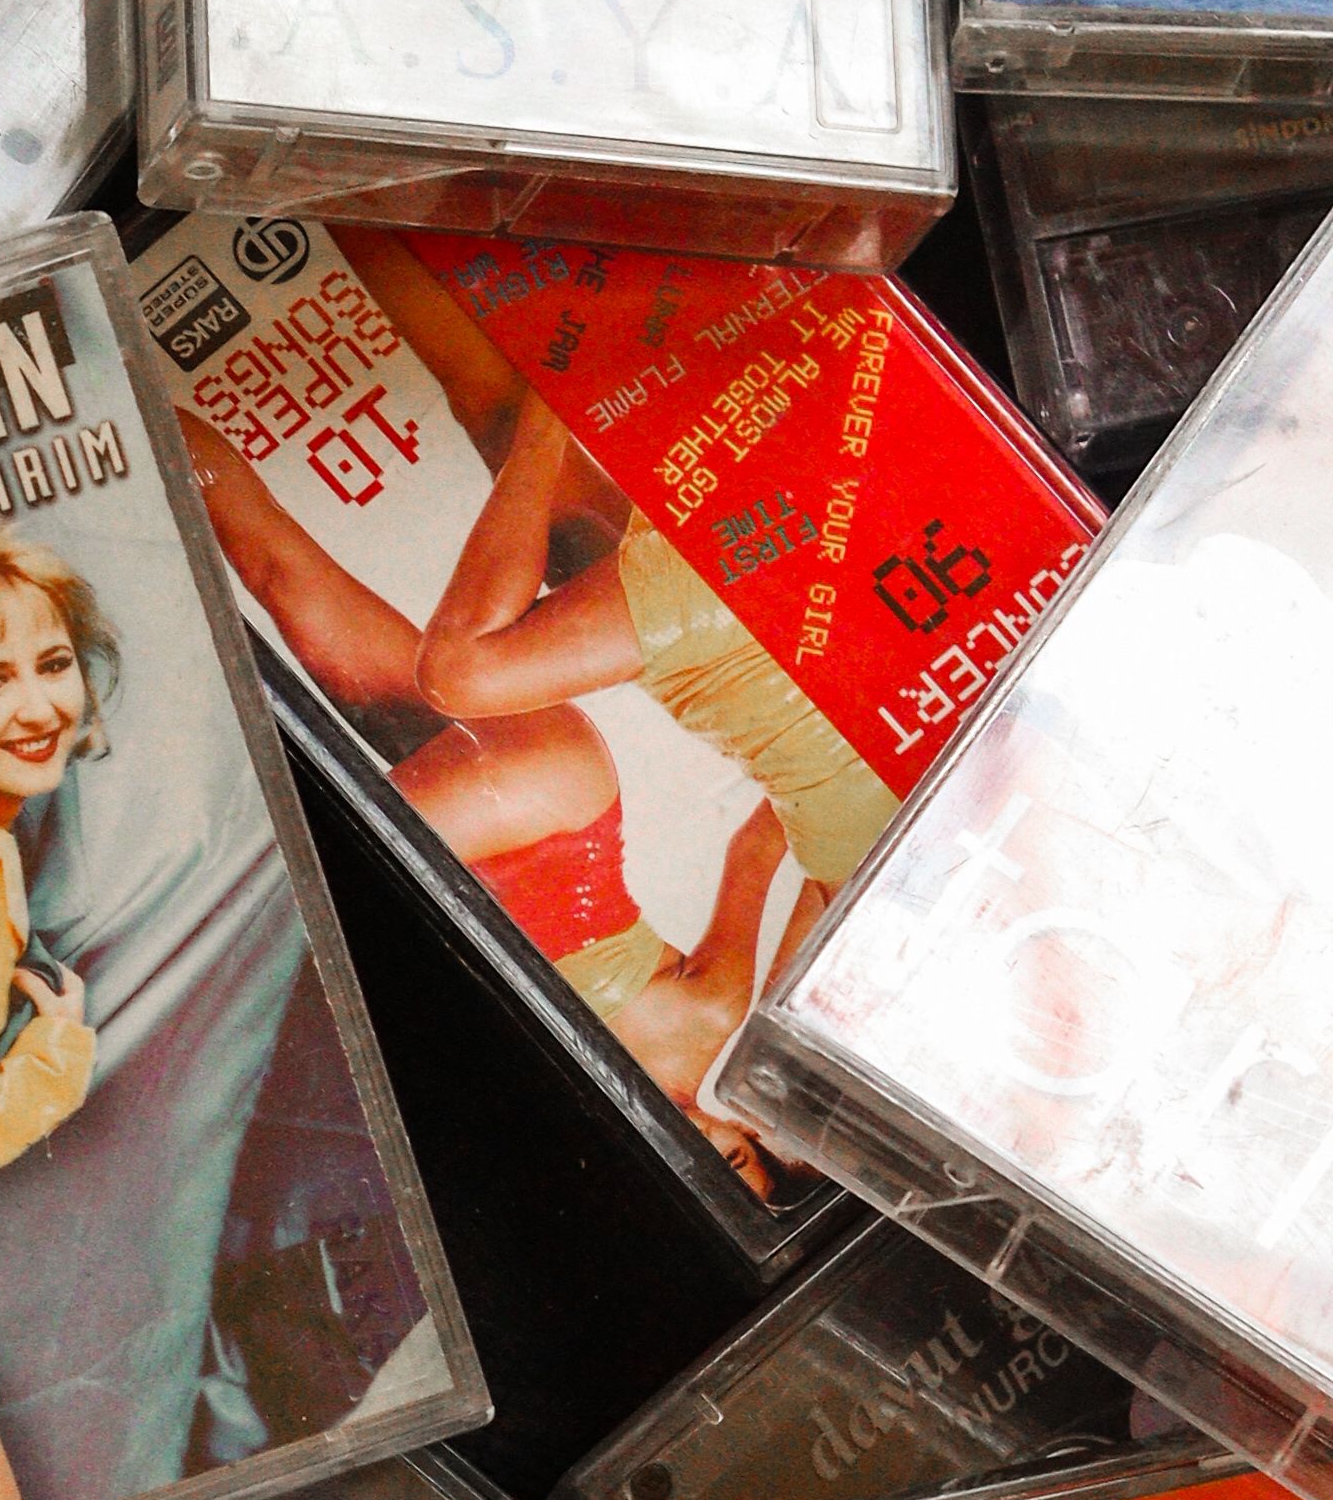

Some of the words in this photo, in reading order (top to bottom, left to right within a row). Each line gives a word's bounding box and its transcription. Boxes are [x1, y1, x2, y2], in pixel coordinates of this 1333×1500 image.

[167, 292, 240, 362] RAKS
[186, 258, 371, 436] SONGS
[221, 296, 406, 473] SUPER
[296, 379, 435, 517] 10
[645, 343, 790, 487] TOGETHER
[714, 351, 826, 463] ALMOST
[814, 476, 862, 567] YOUR
[791, 580, 835, 669] GIRL
